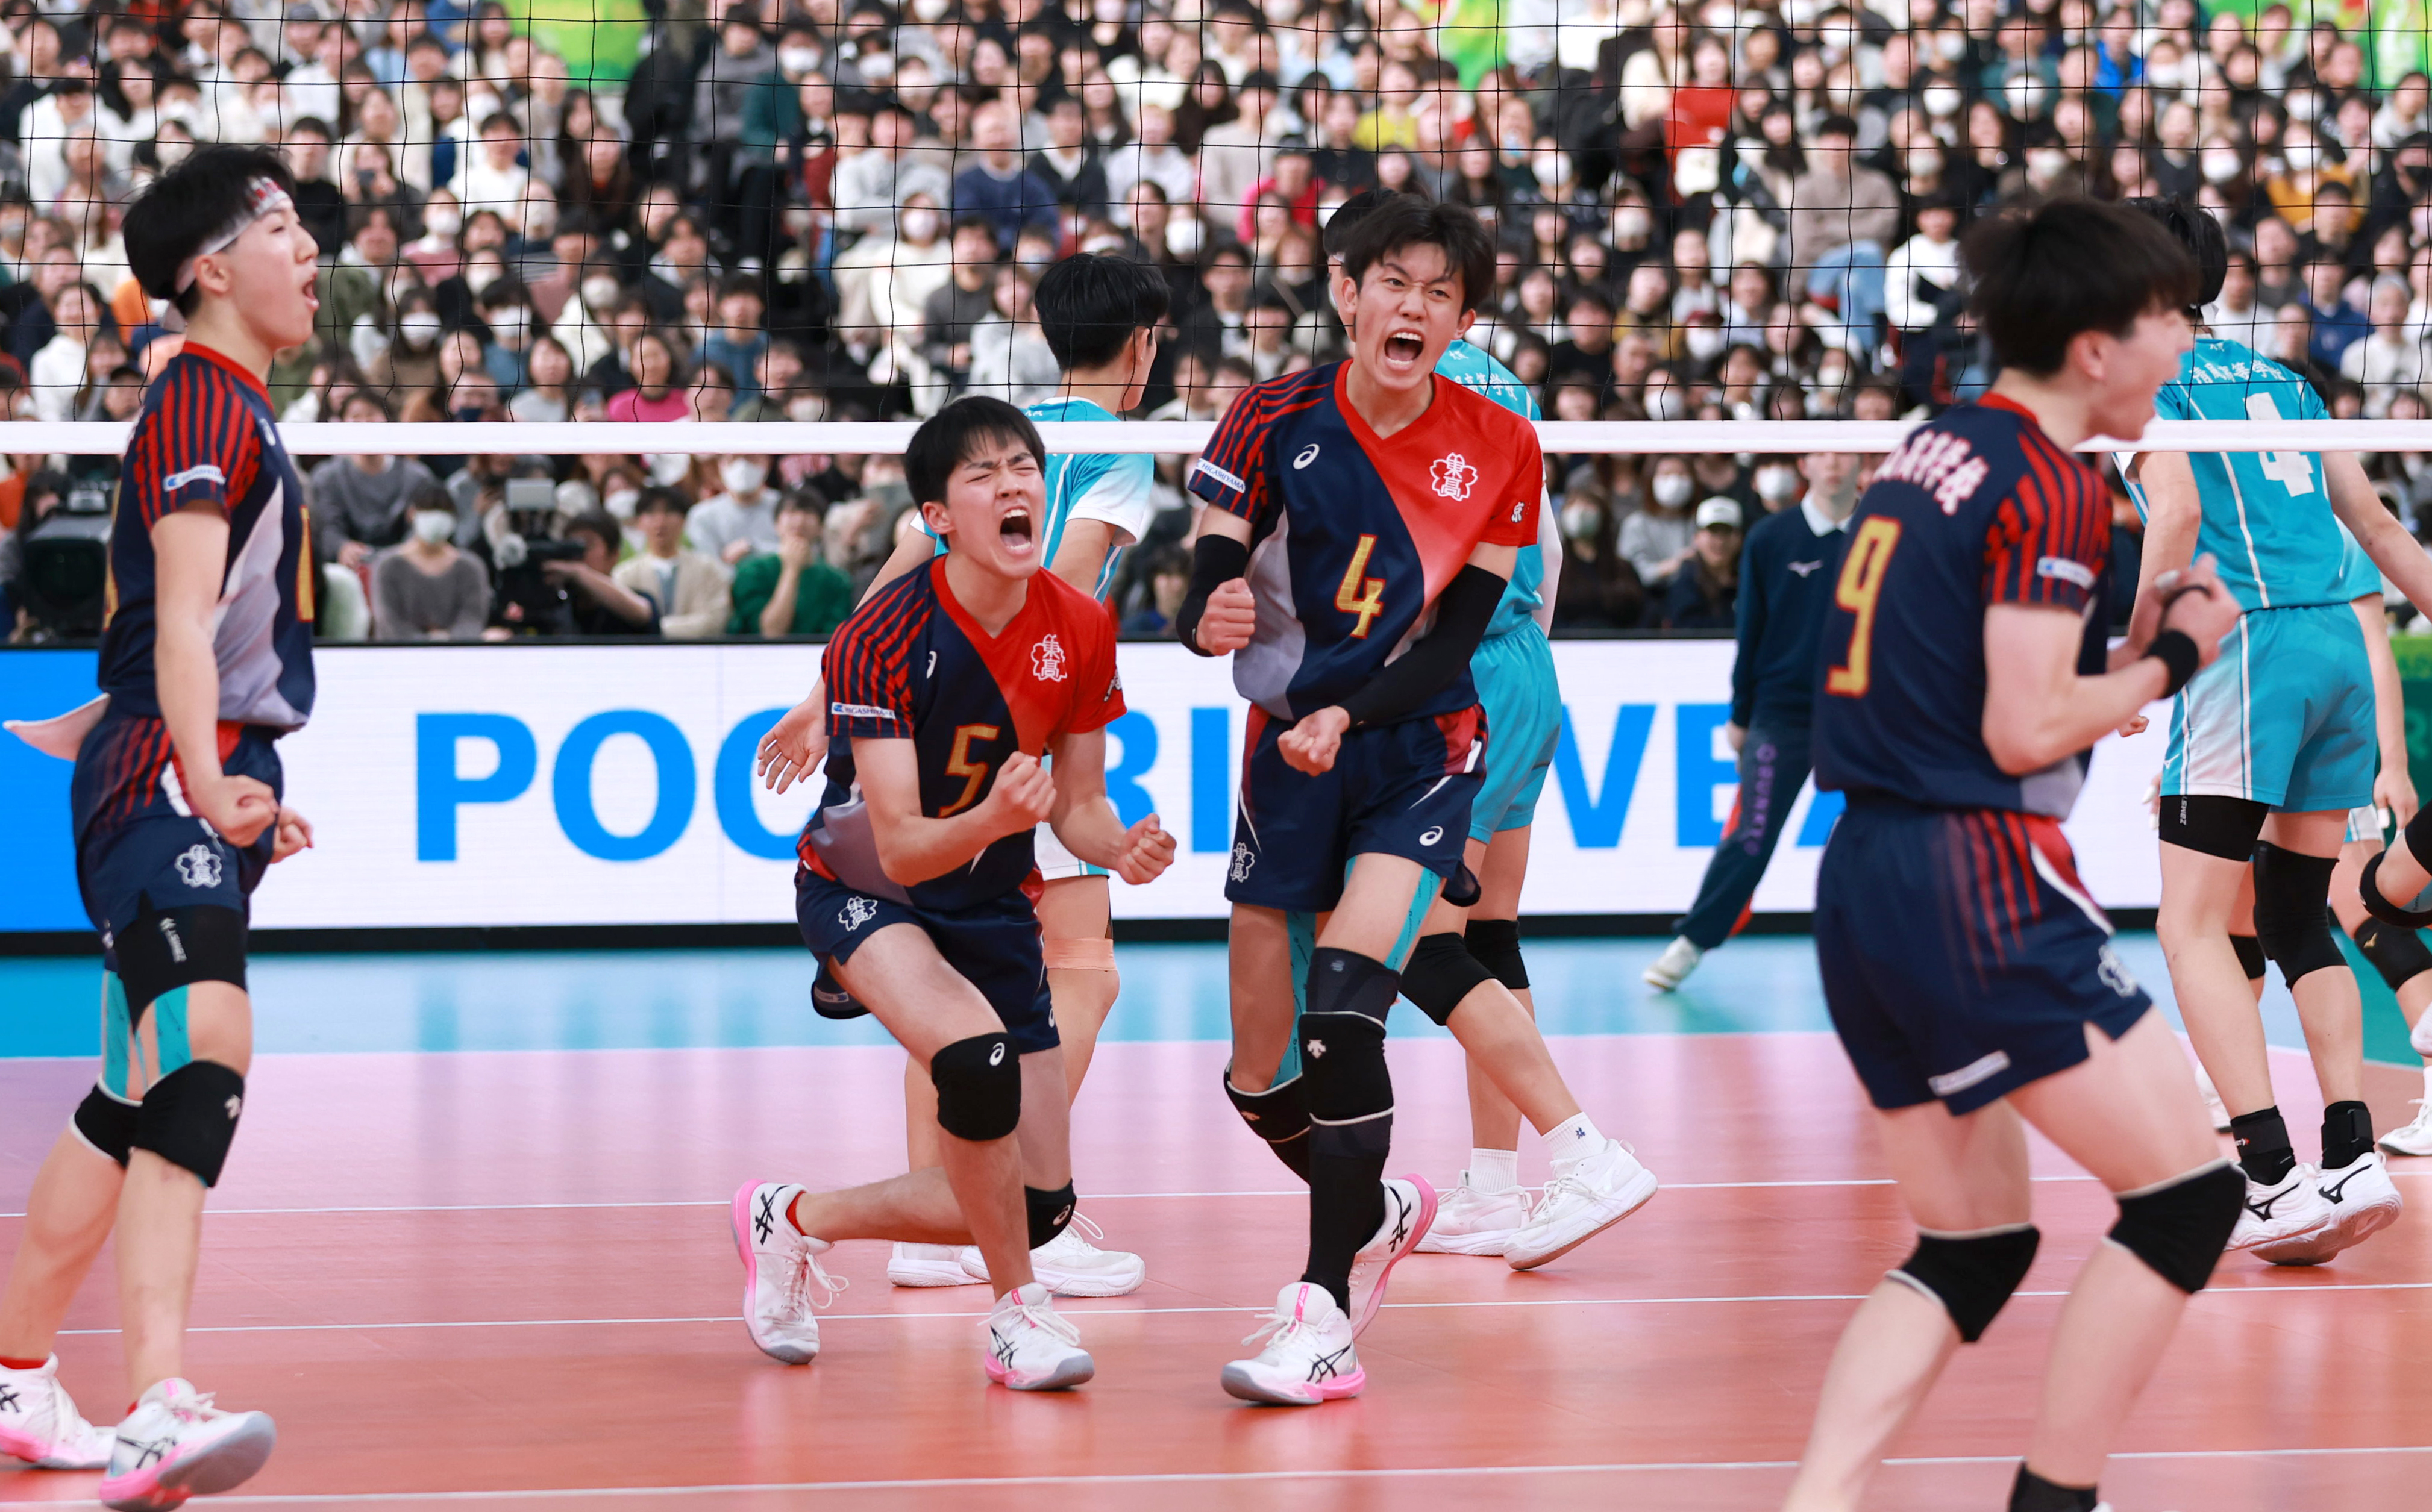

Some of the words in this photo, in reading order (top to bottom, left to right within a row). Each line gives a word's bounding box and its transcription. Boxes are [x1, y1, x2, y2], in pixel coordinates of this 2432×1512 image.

[1202, 463, 1244, 491] HIGASHIYAMA
[2242, 392, 2314, 497] 4
[1334, 533, 1386, 639] 4
[1825, 513, 1903, 700] 9
[938, 723, 1001, 818] 5
